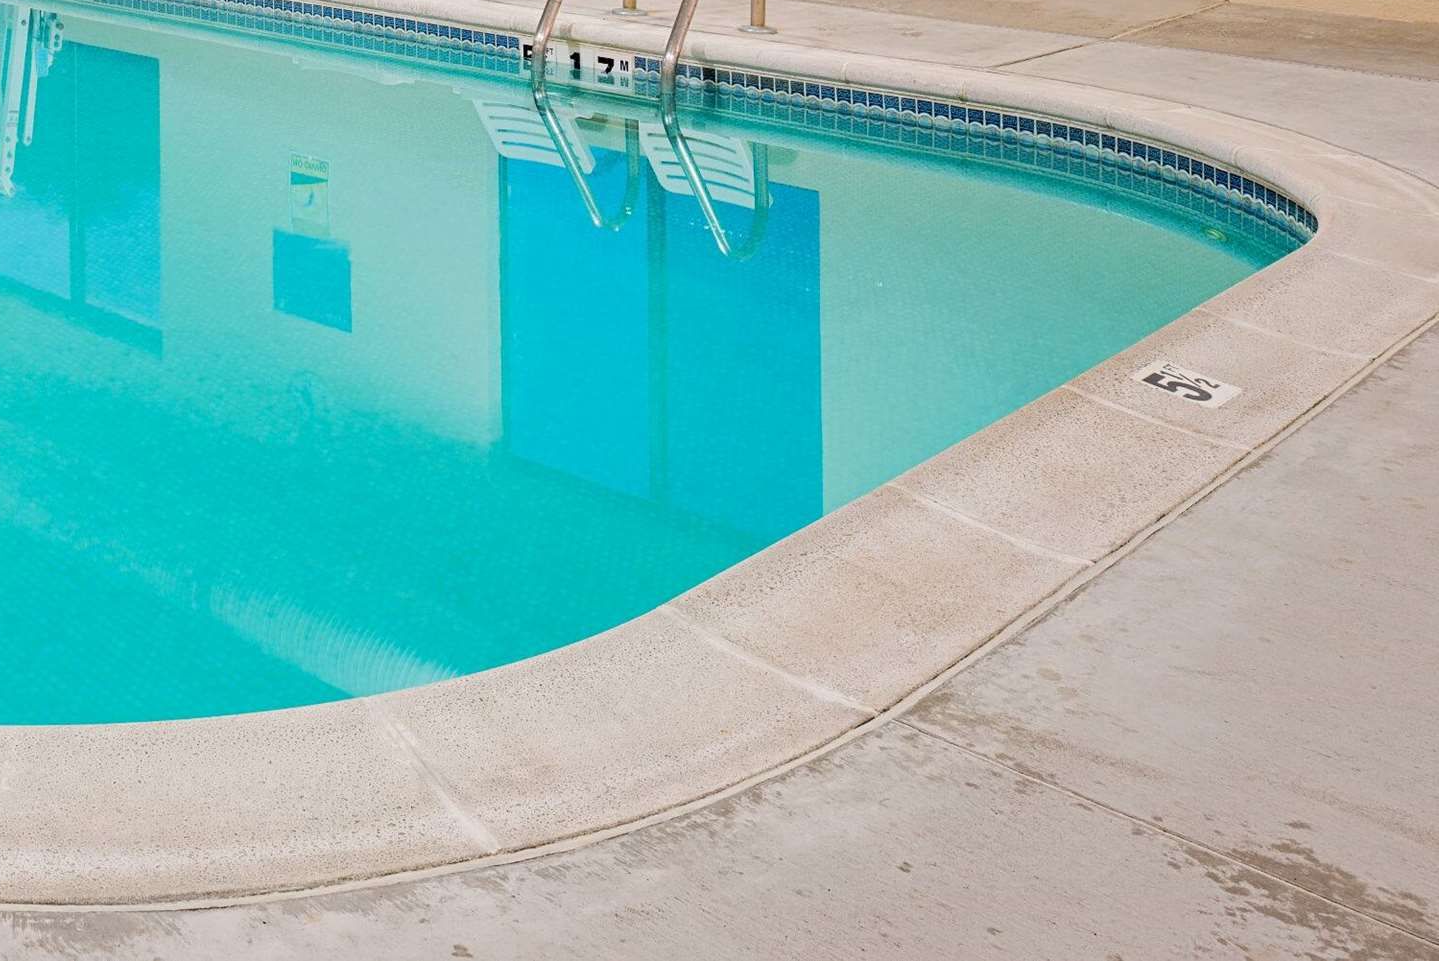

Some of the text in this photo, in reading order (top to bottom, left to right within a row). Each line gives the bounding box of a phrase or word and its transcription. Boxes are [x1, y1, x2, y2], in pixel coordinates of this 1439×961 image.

[570, 52, 580, 70] 1
[597, 56, 614, 74] 7
[620, 60, 629, 72] M
